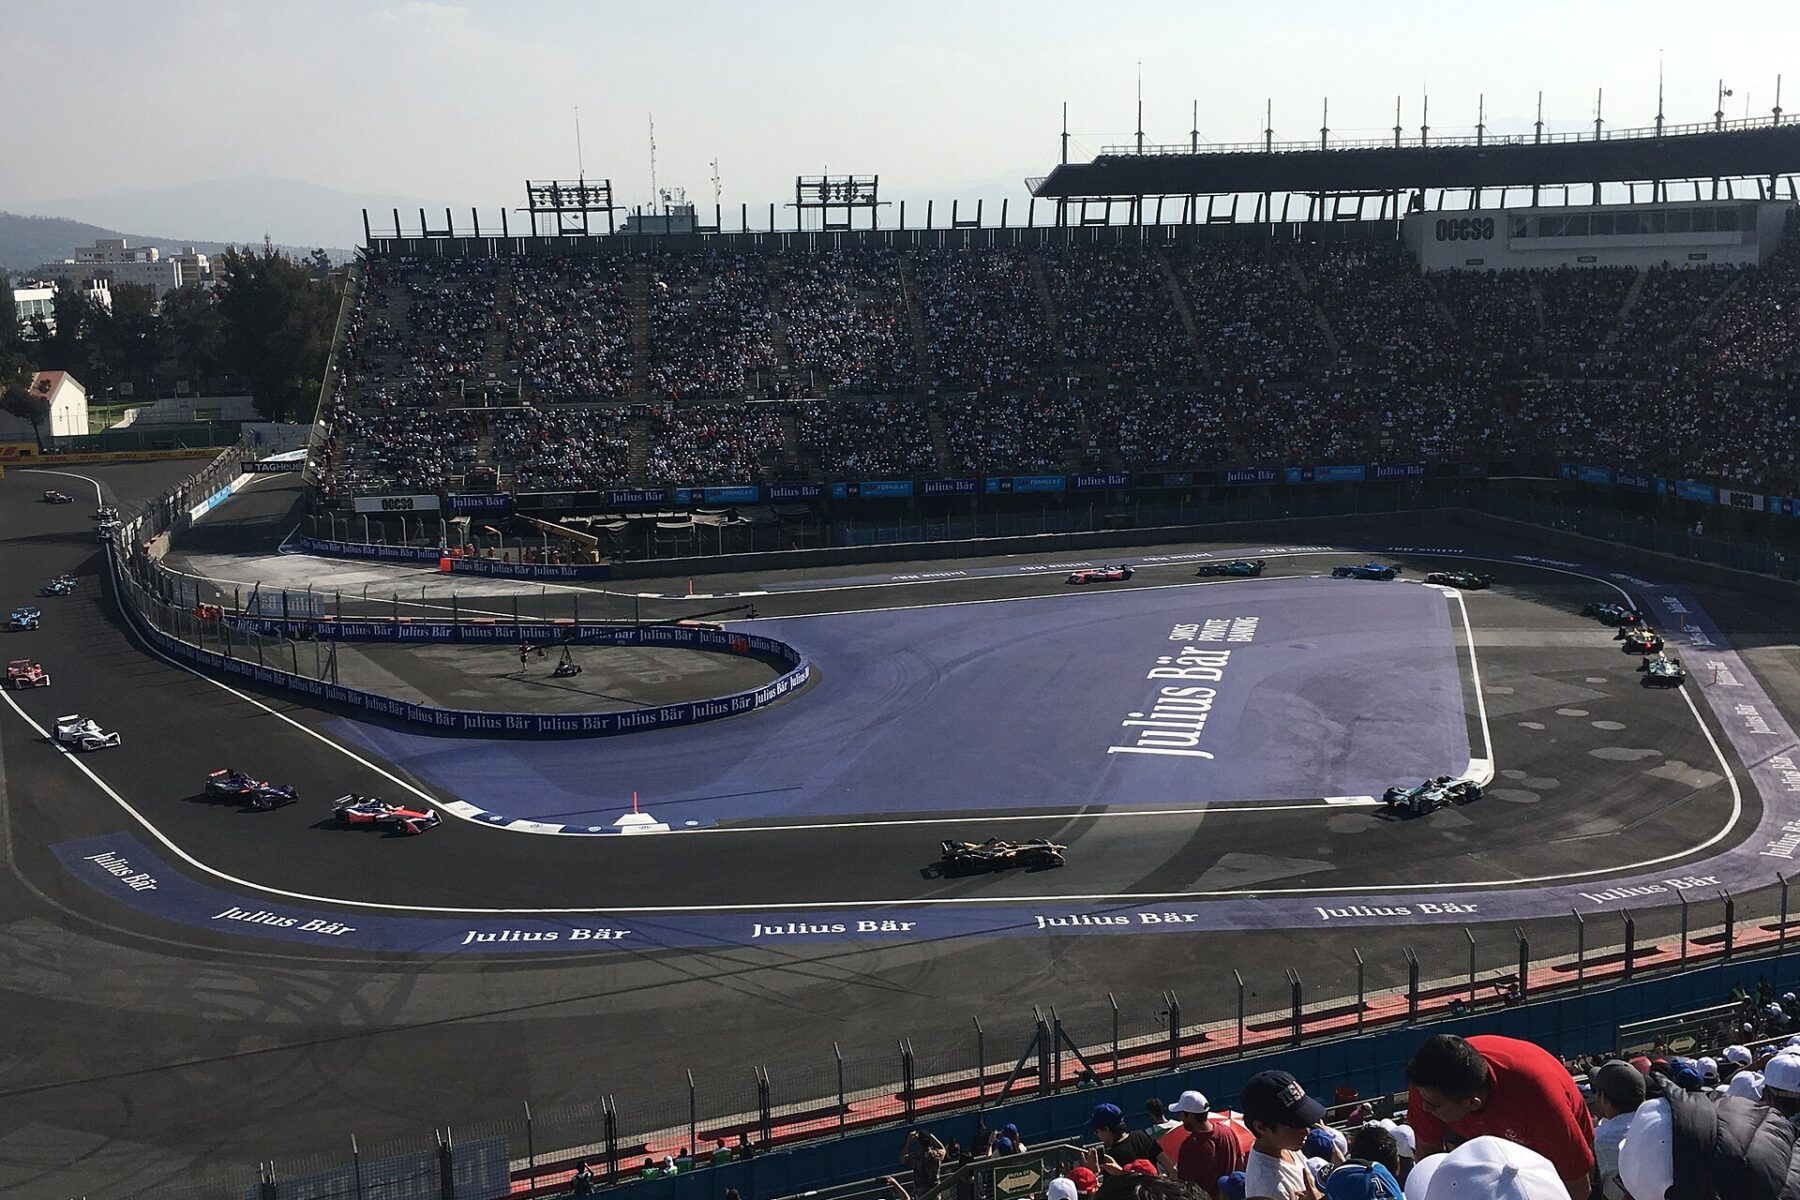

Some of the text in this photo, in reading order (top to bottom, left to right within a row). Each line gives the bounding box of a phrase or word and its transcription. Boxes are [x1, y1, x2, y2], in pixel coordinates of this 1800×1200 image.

[1227, 471, 1275, 482] Julius Bär
[1377, 465, 1425, 477] Julius Bär
[925, 481, 953, 493] Julius
[956, 481, 975, 491] Bär
[1077, 476, 1126, 488] Julius Bär
[613, 492, 642, 504] Julius
[645, 491, 665, 501] Bär
[770, 486, 820, 498] Julius Bär
[453, 495, 505, 508] Julius Bär
[378, 546, 414, 558] Julius Bär
[417, 547, 440, 559] Julius
[453, 560, 488, 572] Julius Bär
[491, 563, 530, 575] Julius Bär
[534, 566, 578, 576] Julius Bär
[318, 623, 336, 634] Bär
[342, 624, 392, 636] Julius Bär
[398, 625, 452, 637] Julius Bär
[461, 626, 516, 638] Julius Bär
[519, 627, 550, 638] Julius
[639, 629, 693, 642] Julius Bär
[700, 631, 726, 644] Julius
[1147, 646, 1231, 681] Bär
[254, 667, 285, 685] Julius Bär
[790, 673, 806, 690] Julius
[288, 676, 322, 695] Julius Bär
[325, 686, 361, 705] Julius Bär
[755, 681, 788, 707] Julius Bär
[365, 695, 404, 715] Julius Bär
[692, 697, 750, 720] Julius Bär
[407, 706, 457, 726] Julius Bär
[463, 715, 531, 729] Julius Bär
[617, 707, 685, 730] Julius Bär
[1107, 686, 1217, 759] Julius
[538, 717, 609, 732] Julius Bär
[84, 851, 157, 892] Julius Bär
[1579, 874, 1721, 904] Julius Bär
[1314, 900, 1478, 921] Julius Bär
[212, 907, 356, 936] Julius Bär
[1034, 909, 1199, 930] Julius Bär
[751, 918, 917, 938] Julius Bär
[461, 926, 631, 948] Julius Bär
